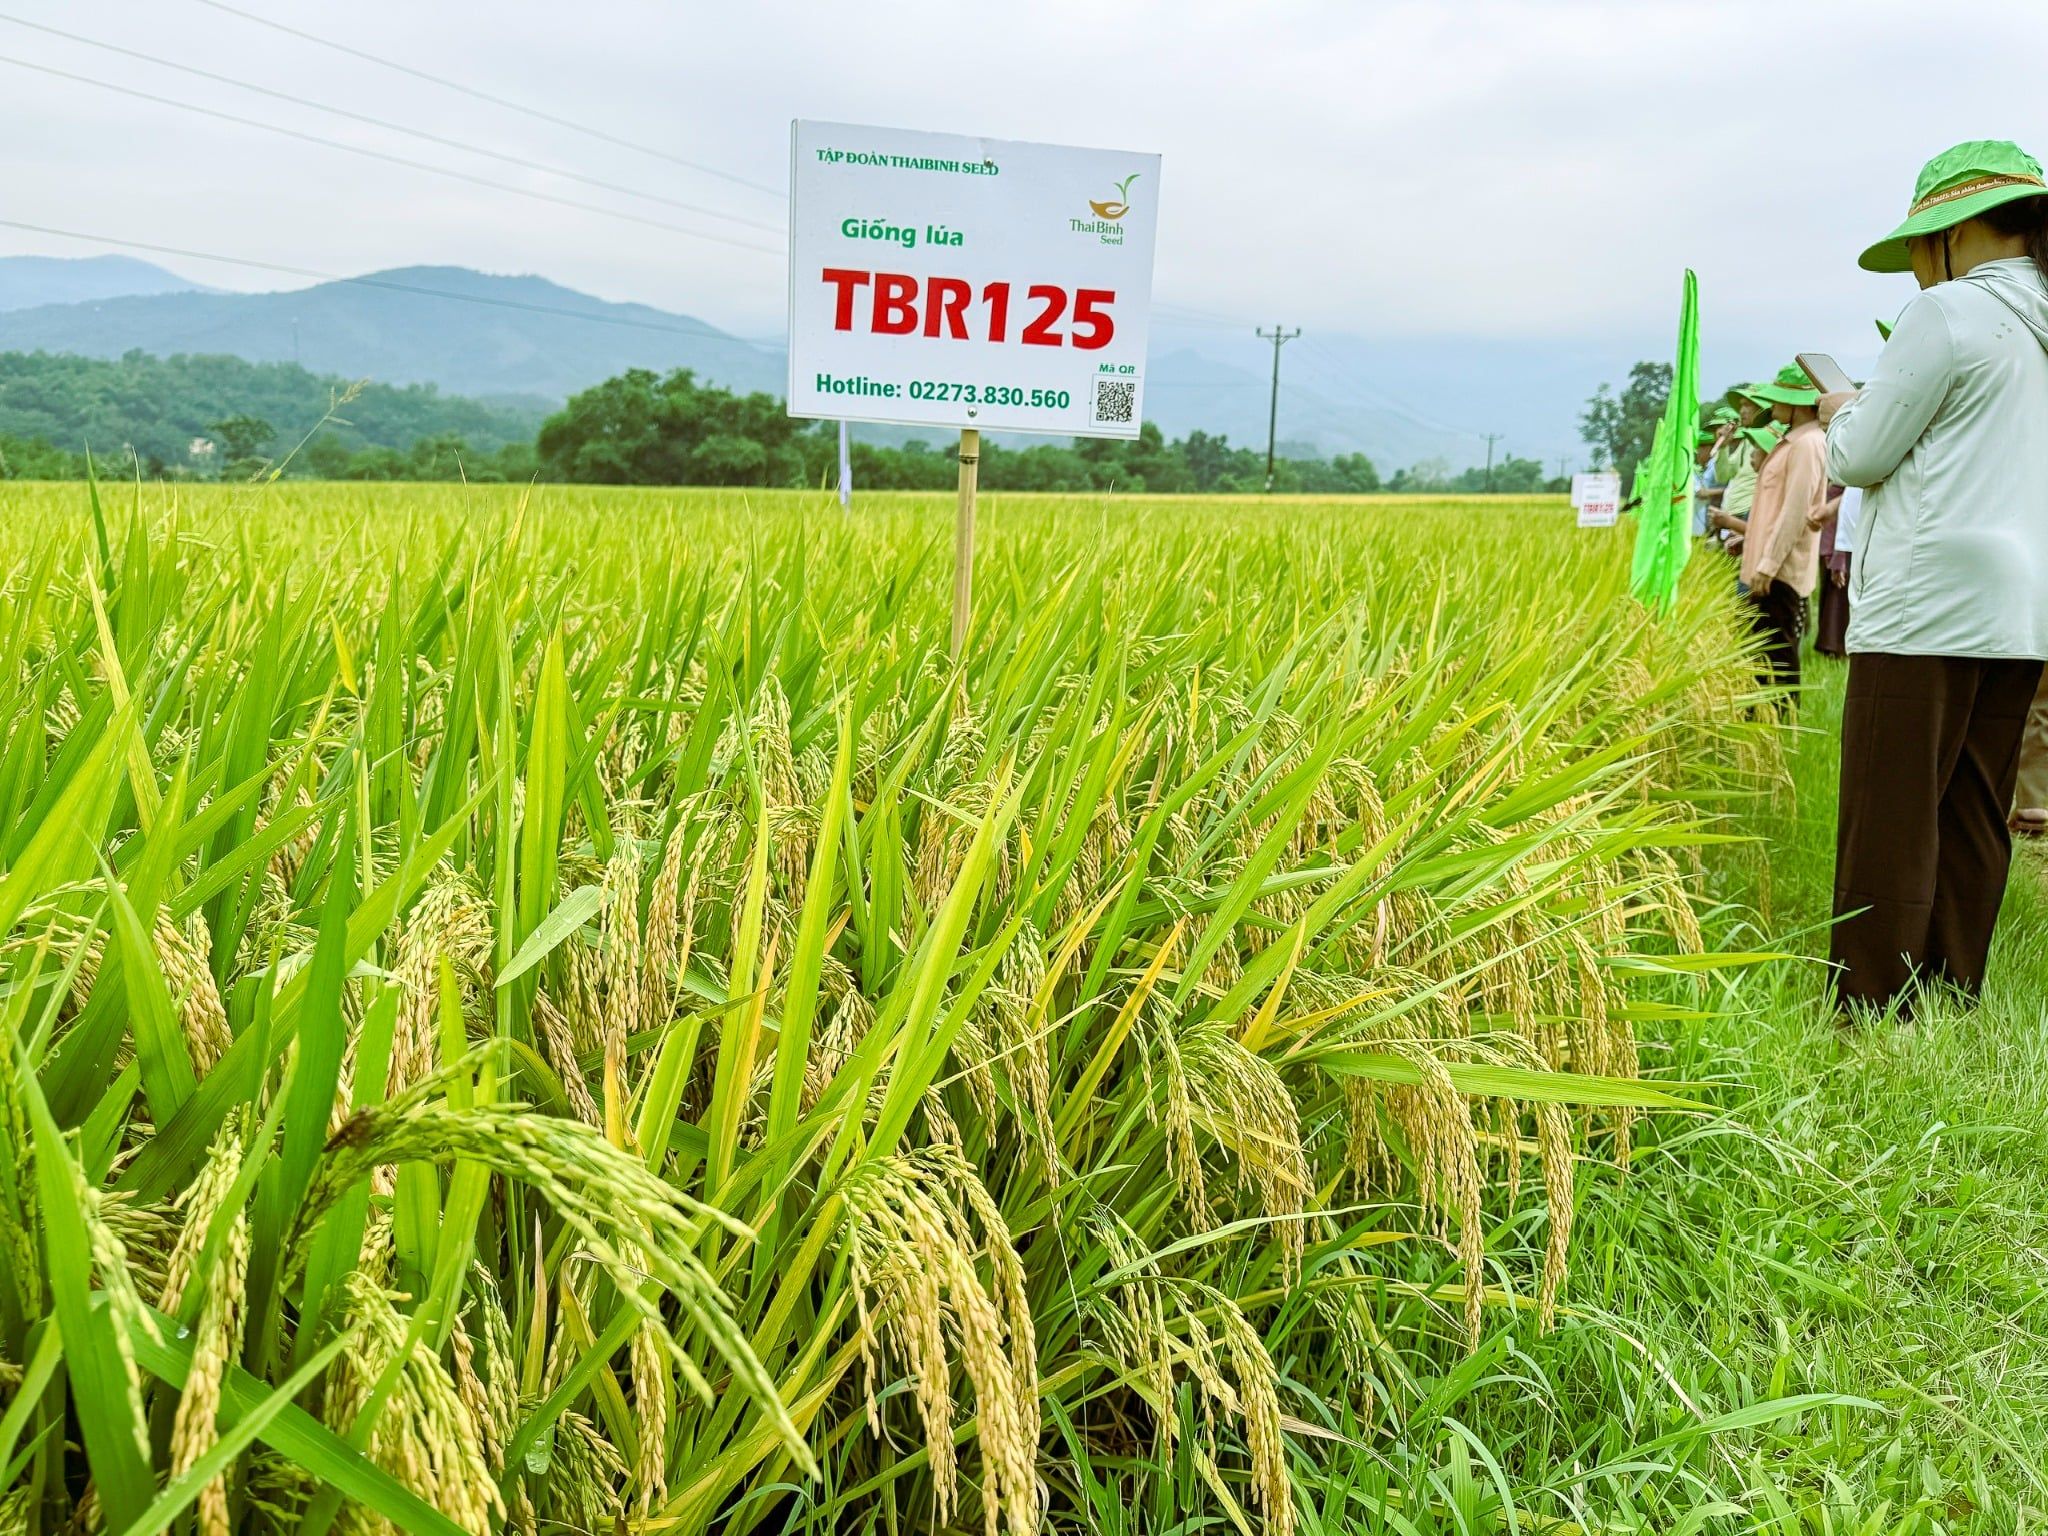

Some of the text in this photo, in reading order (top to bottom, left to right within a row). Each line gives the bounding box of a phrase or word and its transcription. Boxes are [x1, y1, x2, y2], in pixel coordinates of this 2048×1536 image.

[816, 147, 999, 176] TẬP ĐOÀN THAIBINH SEED
[841, 218, 964, 249] Giống lúa
[1101, 235, 1123, 245] Seed
[822, 268, 1116, 350] TBR125
[1099, 363, 1135, 374] Mã QR
[816, 373, 1070, 409] Hotline: 02273.830.560
